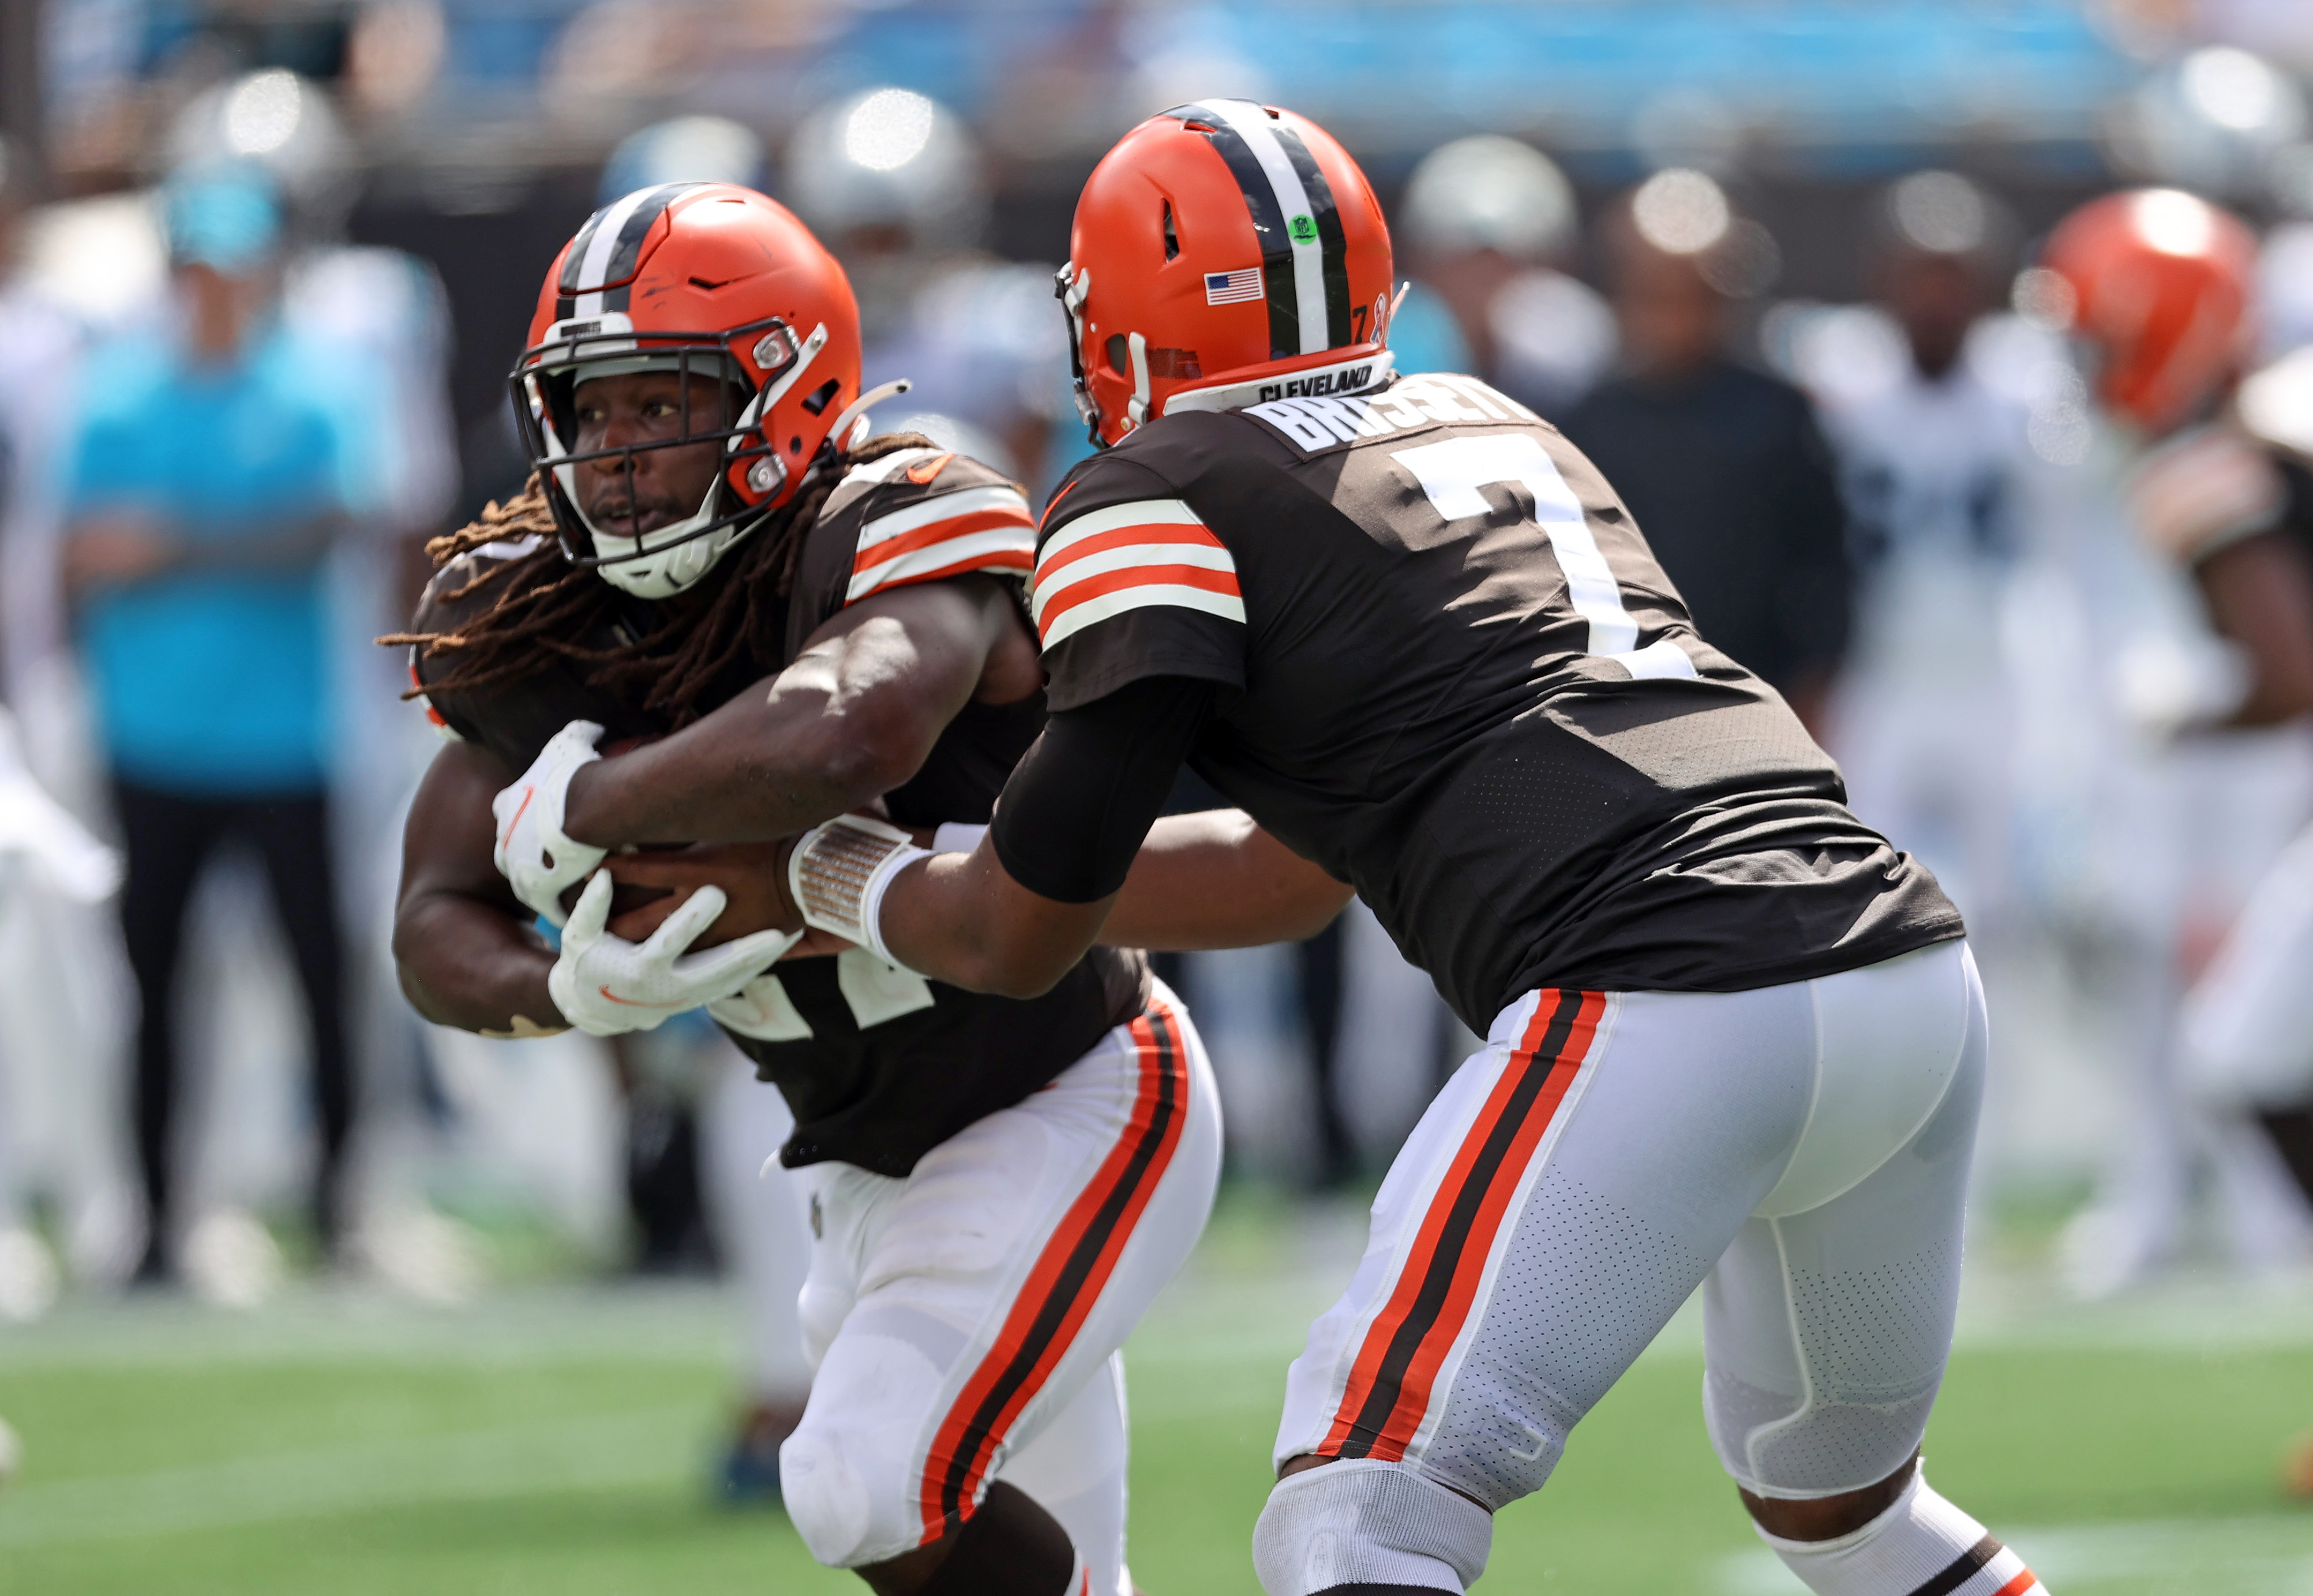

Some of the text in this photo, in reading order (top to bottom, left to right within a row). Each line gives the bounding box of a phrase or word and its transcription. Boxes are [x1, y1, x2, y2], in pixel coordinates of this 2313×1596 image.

[1352, 304, 1367, 344] 7
[1259, 365, 1373, 403] CLEVELAND
[1389, 433, 1698, 679] 7
